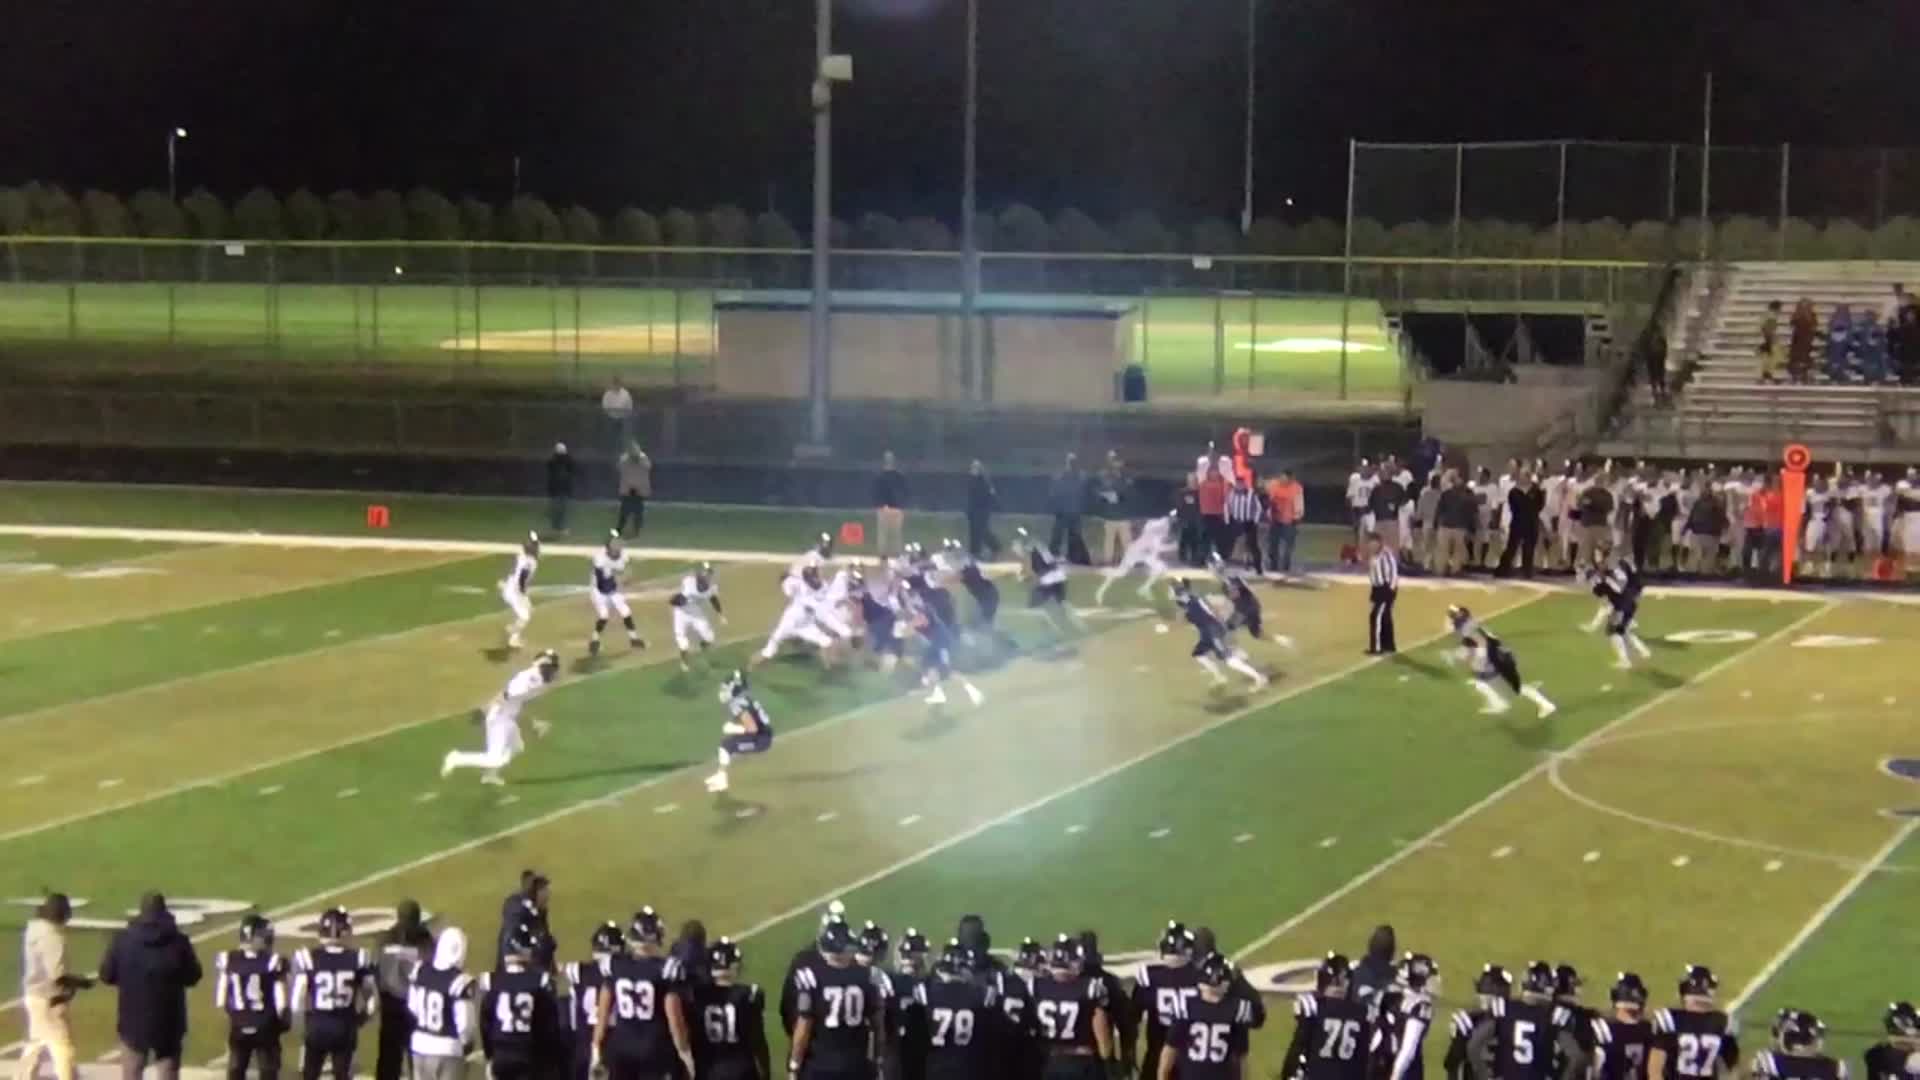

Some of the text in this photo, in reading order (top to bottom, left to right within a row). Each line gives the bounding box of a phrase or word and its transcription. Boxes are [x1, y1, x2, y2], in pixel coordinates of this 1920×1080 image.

[230, 972, 264, 1011] 14
[314, 971, 355, 1010] 25
[408, 985, 443, 1032] 48
[615, 978, 655, 1020] 63
[823, 985, 864, 1028] 70
[496, 992, 534, 1032] 43
[704, 1003, 737, 1044] 61
[931, 1008, 975, 1046] 78
[1188, 1023, 1231, 1063] 35
[1319, 1018, 1361, 1060] 76
[1512, 1020, 1536, 1064] 5
[1677, 1034, 1721, 1077] 27
